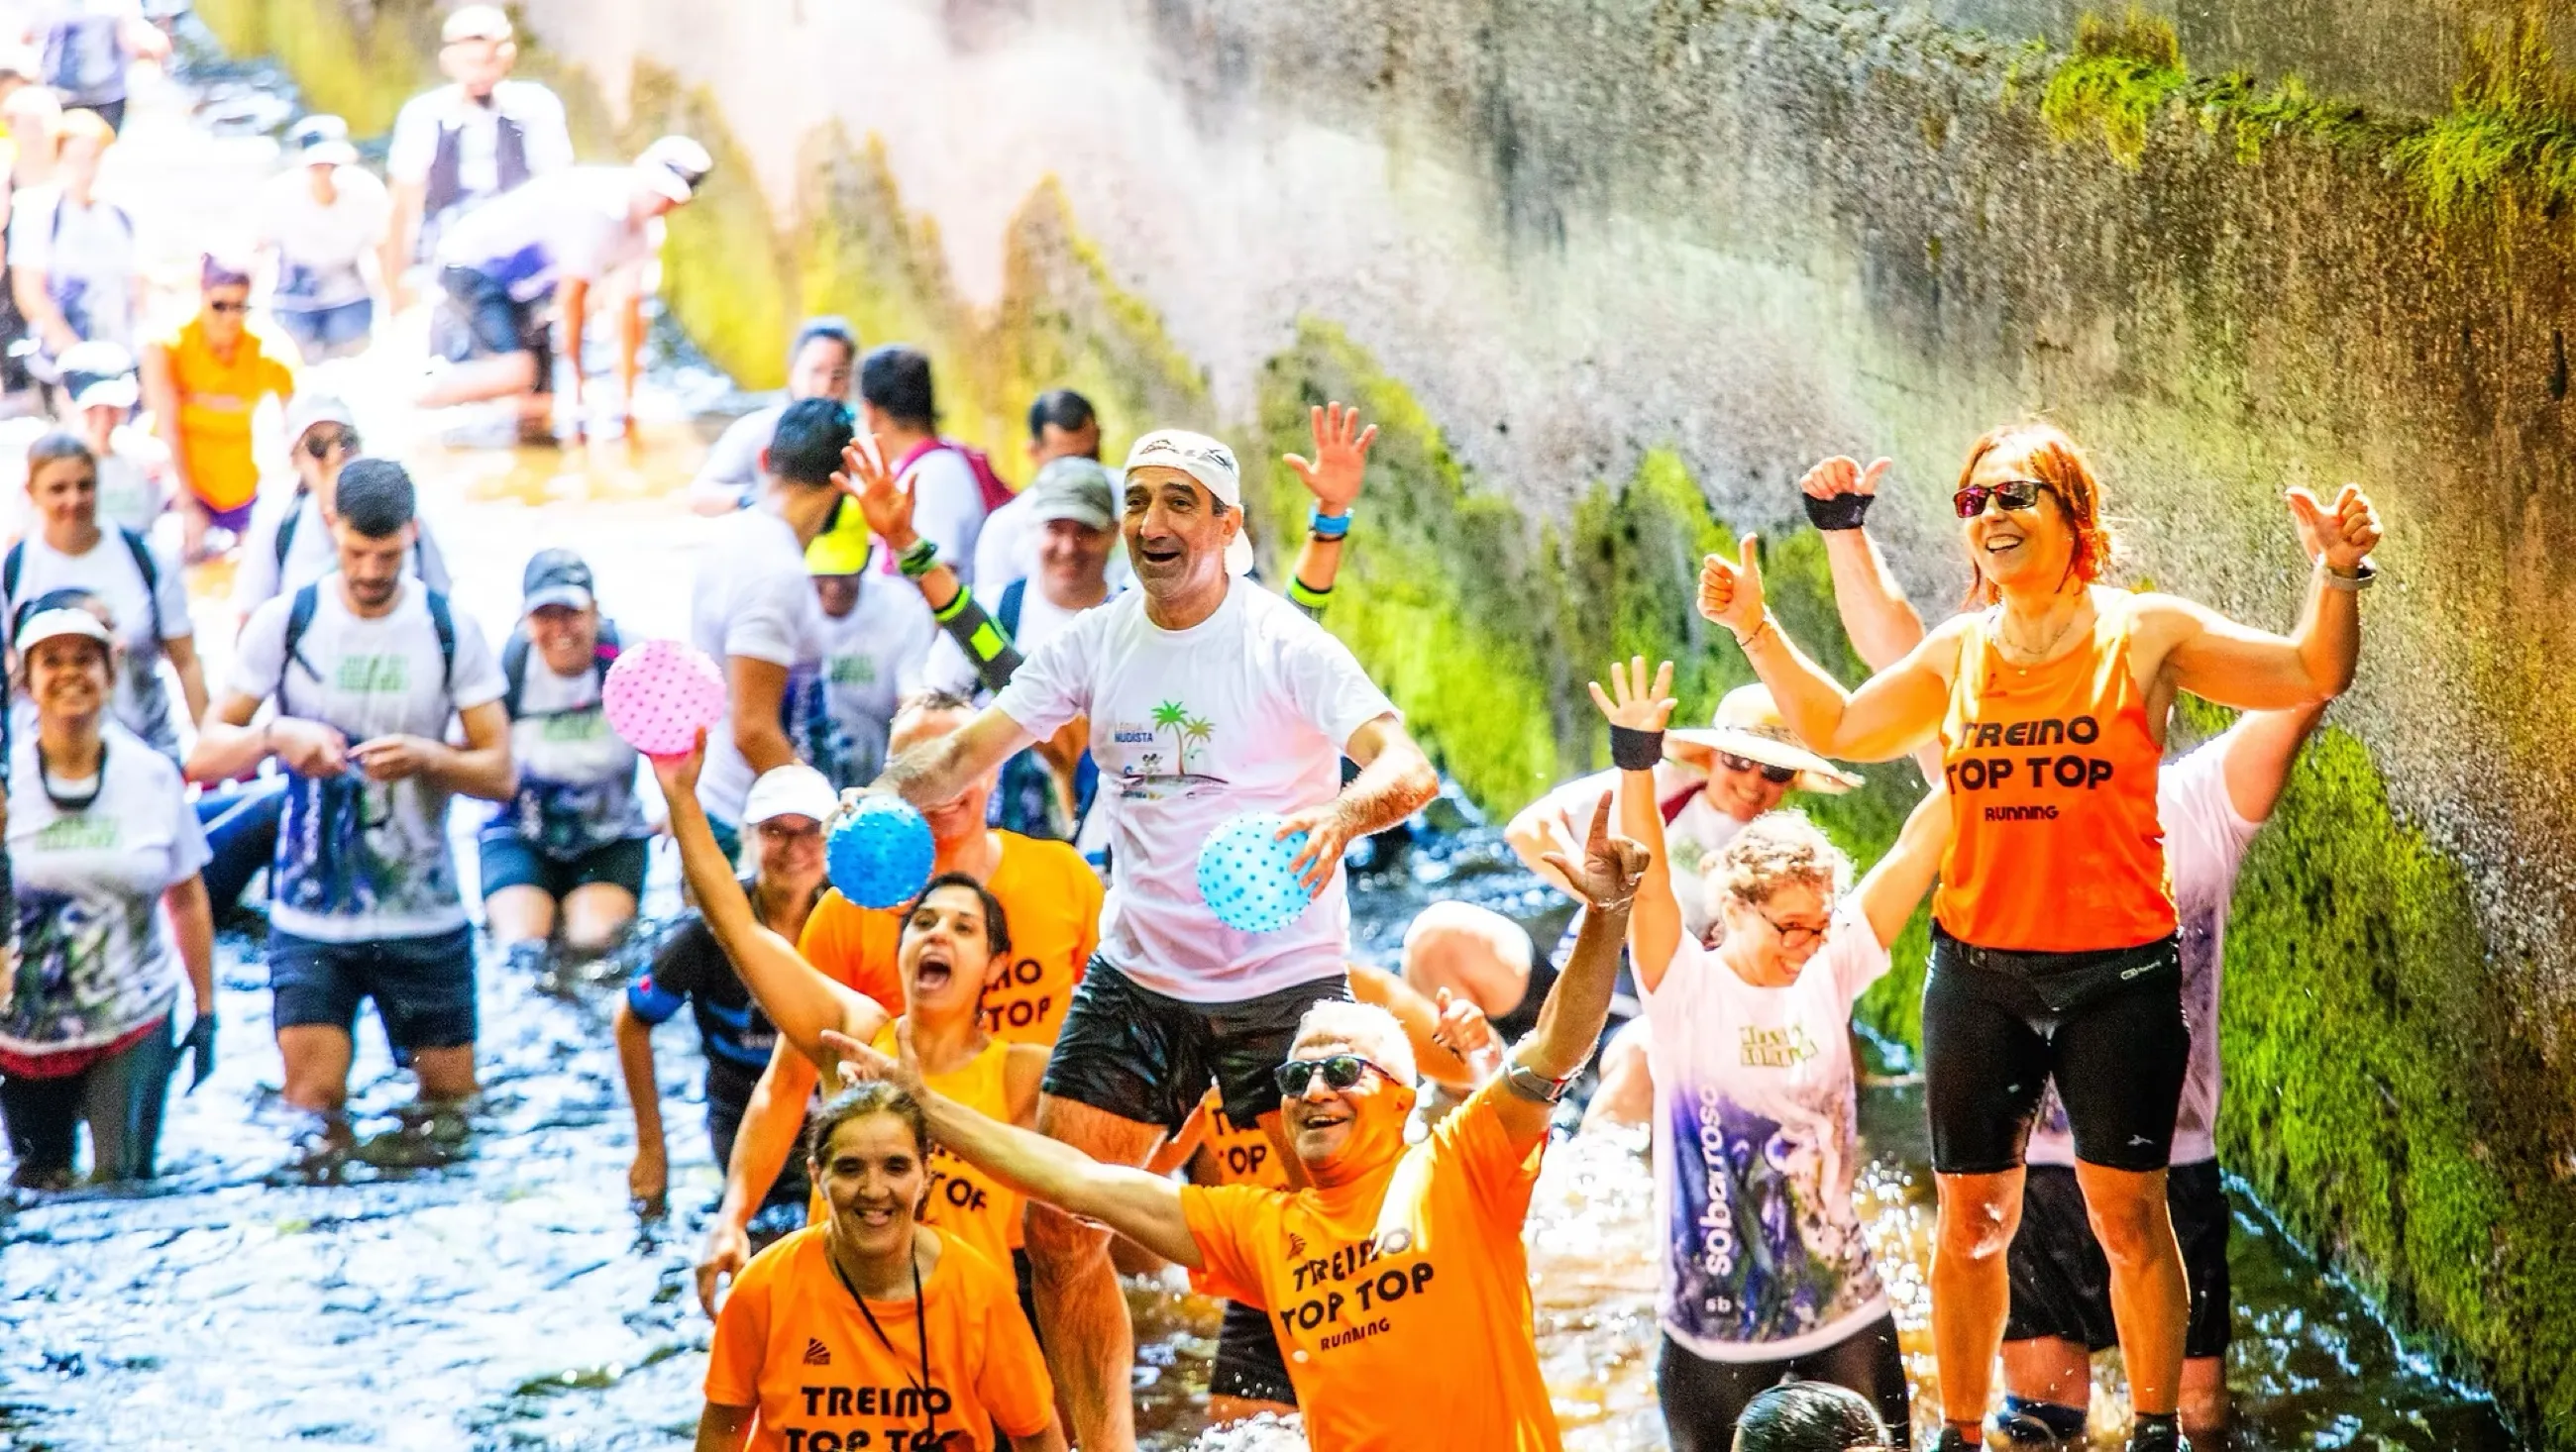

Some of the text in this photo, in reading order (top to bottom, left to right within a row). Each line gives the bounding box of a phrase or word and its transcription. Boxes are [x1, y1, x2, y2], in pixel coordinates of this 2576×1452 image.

[1958, 714, 2099, 750] TREINO
[1947, 755, 2113, 795] TOP TOP
[1985, 804, 2060, 822] RUNNING
[1219, 1144, 1267, 1176] OP
[1699, 1086, 1733, 1277] sobarroso
[1292, 1227, 1413, 1293] TREINO
[1280, 1262, 1435, 1337] TOP TOP
[1320, 1316, 1391, 1351] RUNNING
[801, 1387, 952, 1417] TREINO
